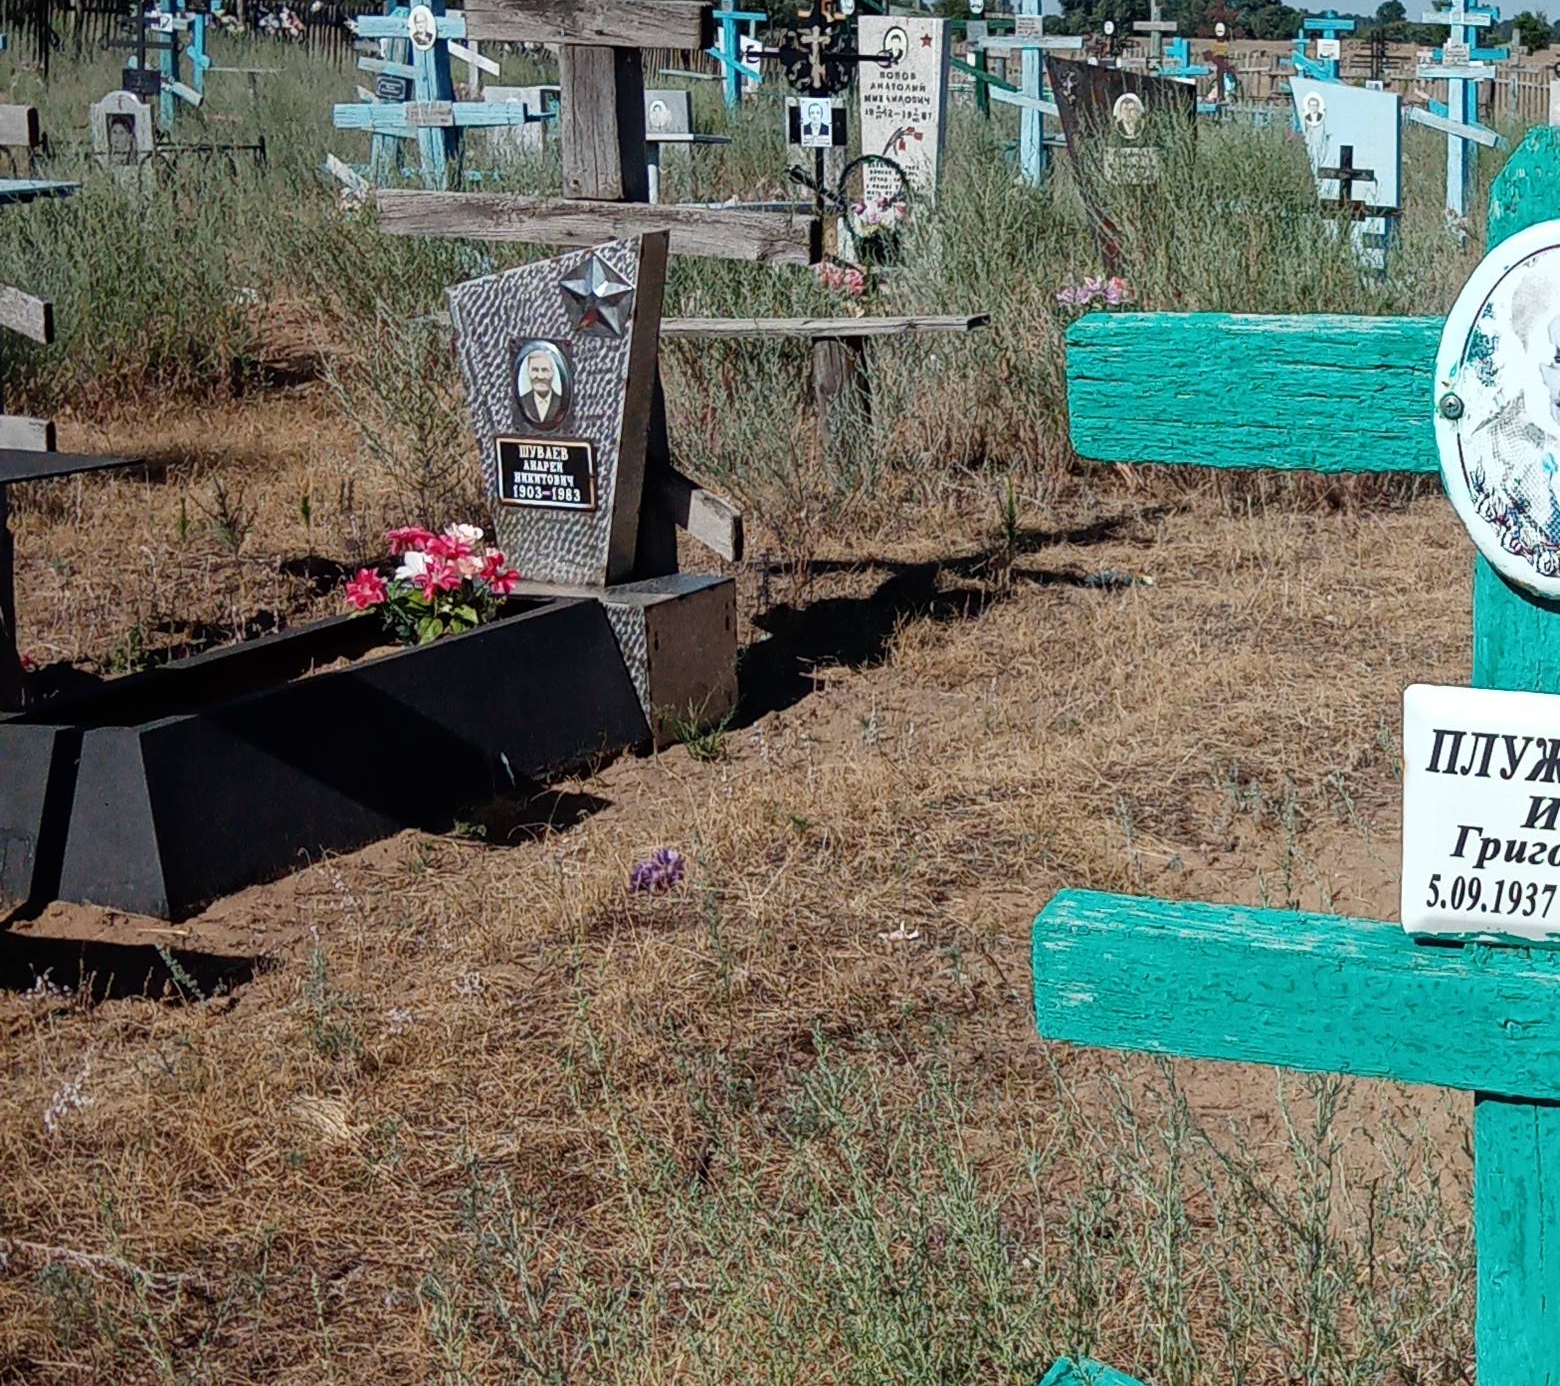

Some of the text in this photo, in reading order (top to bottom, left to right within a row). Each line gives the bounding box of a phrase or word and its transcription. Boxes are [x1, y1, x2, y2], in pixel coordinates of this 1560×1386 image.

[519, 445, 569, 461] ШУВАЕВ
[513, 472, 574, 487] НИКИТОВИЧ
[1425, 873, 1557, 918] 5.09.1937
